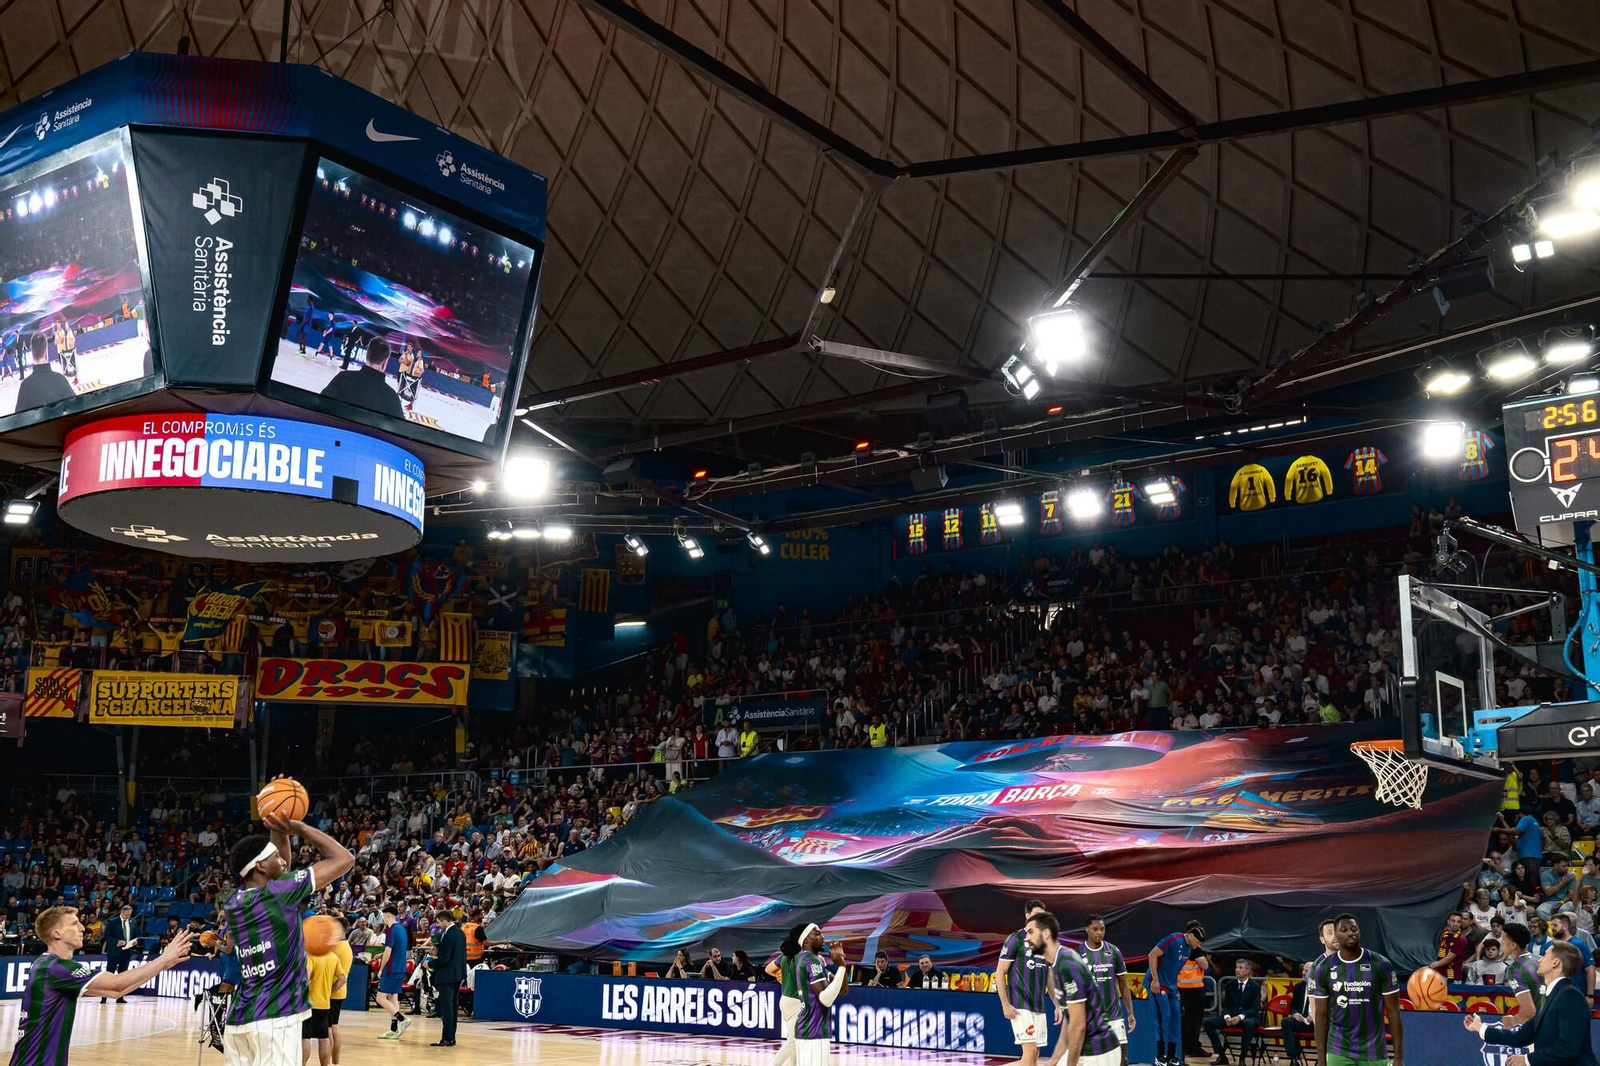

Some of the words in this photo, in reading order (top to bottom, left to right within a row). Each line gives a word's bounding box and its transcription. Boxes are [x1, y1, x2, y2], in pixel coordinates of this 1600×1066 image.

[53, 97, 93, 121] Assistència
[53, 113, 81, 132] Sanitària
[458, 171, 493, 195] Sanitària
[459, 162, 506, 191] Assistència
[193, 235, 213, 312] Sanitària
[211, 236, 236, 346] Assistència
[1542, 399, 1597, 429] 2:56
[142, 421, 158, 435] EL
[258, 422, 276, 439] ÉS
[1465, 443, 1478, 460] 8
[99, 437, 326, 489] INNEGOCIABLE
[1355, 458, 1376, 476] 14
[1247, 476, 1256, 491] 1
[1297, 467, 1318, 484] 16
[1113, 492, 1131, 508] 21
[1045, 503, 1054, 518] 7
[1539, 509, 1598, 523] CUPRA
[944, 519, 960, 534] 12
[982, 514, 997, 528] 11
[205, 530, 379, 544] Assistència
[908, 523, 924, 538] 15
[210, 540, 332, 549] Sanitària
[780, 542, 830, 561] CULER
[260, 658, 466, 700] DRACS
[96, 680, 235, 700] SUPPORTERS
[297, 685, 421, 700] 1991
[999, 784, 1083, 805] BARÇA
[240, 941, 272, 958] Unicaja
[6, 962, 32, 992] LE
[241, 959, 276, 979] álaga
[602, 983, 639, 1021] LES
[641, 985, 723, 1027] ARRELS
[726, 984, 775, 1029] SÓN
[1499, 1046, 1522, 1055] FCB
